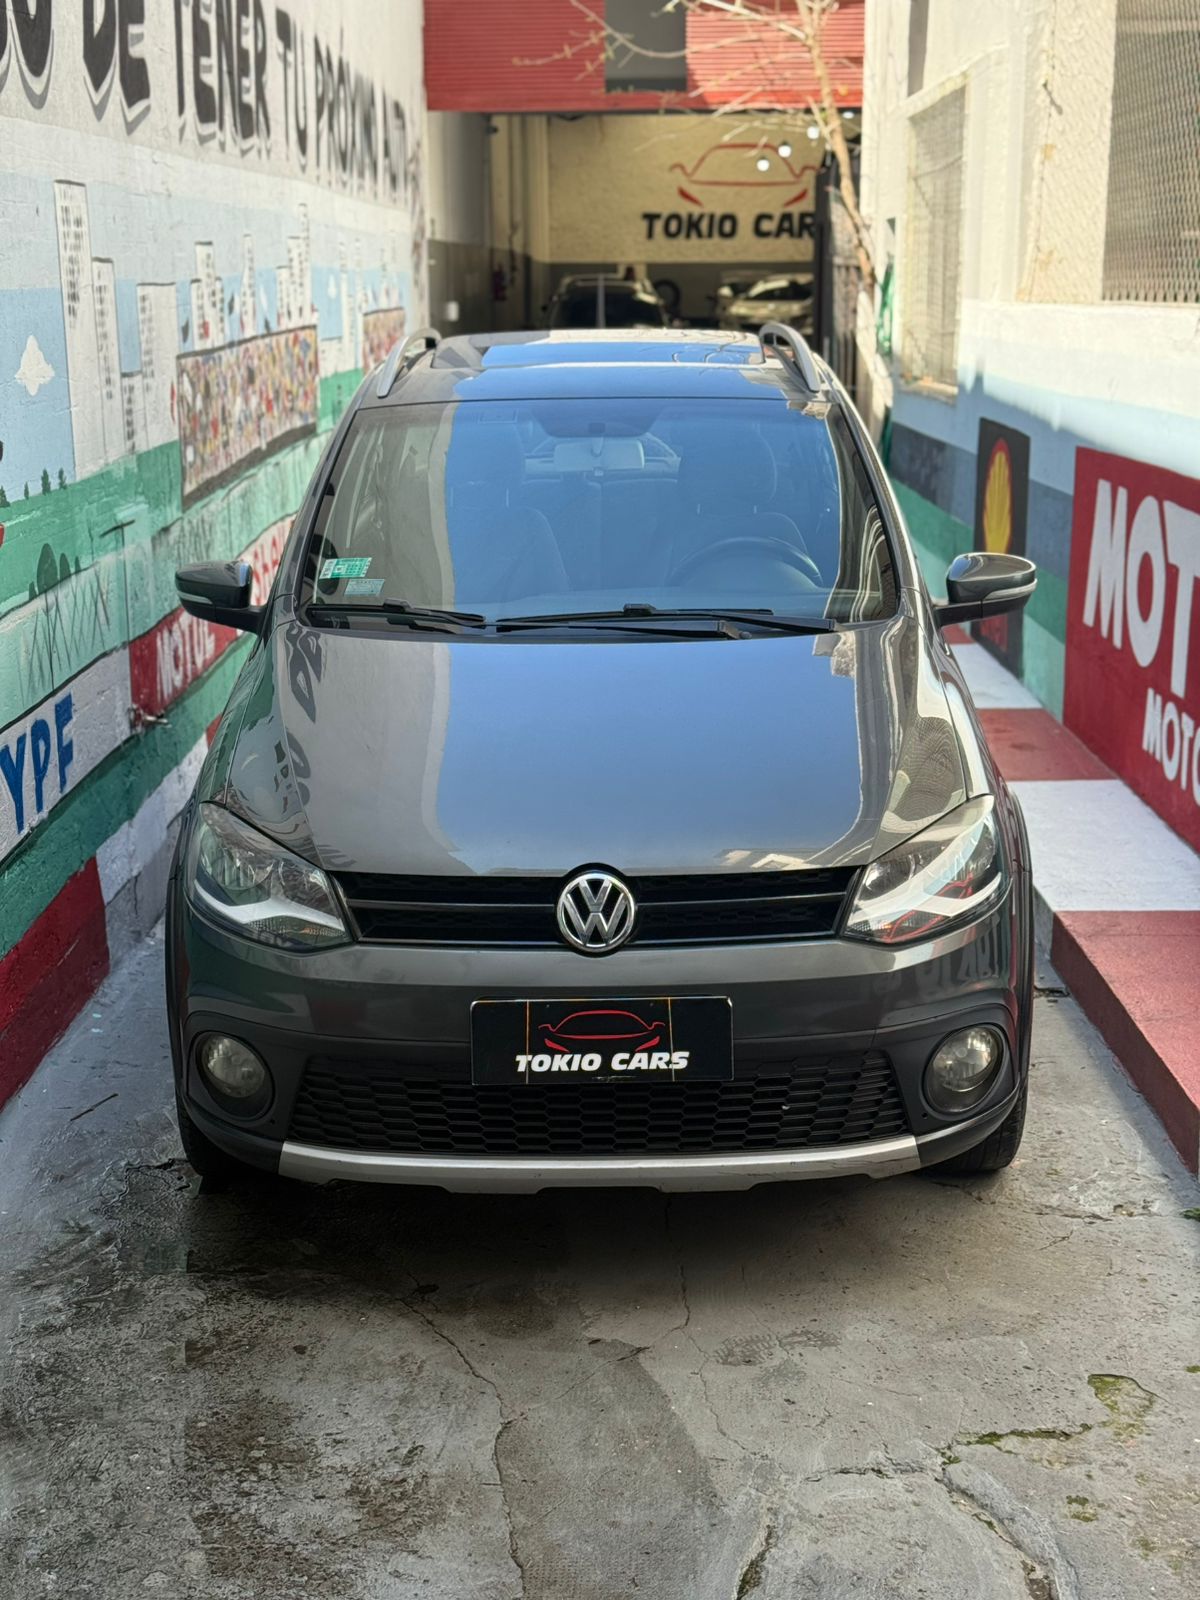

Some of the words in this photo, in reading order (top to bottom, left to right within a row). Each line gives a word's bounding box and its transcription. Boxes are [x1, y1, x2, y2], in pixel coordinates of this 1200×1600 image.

[173, 0, 270, 141] TENER
[642, 212, 738, 240] TOKIO
[1082, 478, 1200, 699] MOT
[0, 692, 74, 834] YPF
[515, 1053, 602, 1072] TOKIO
[611, 1051, 690, 1071] CARS
